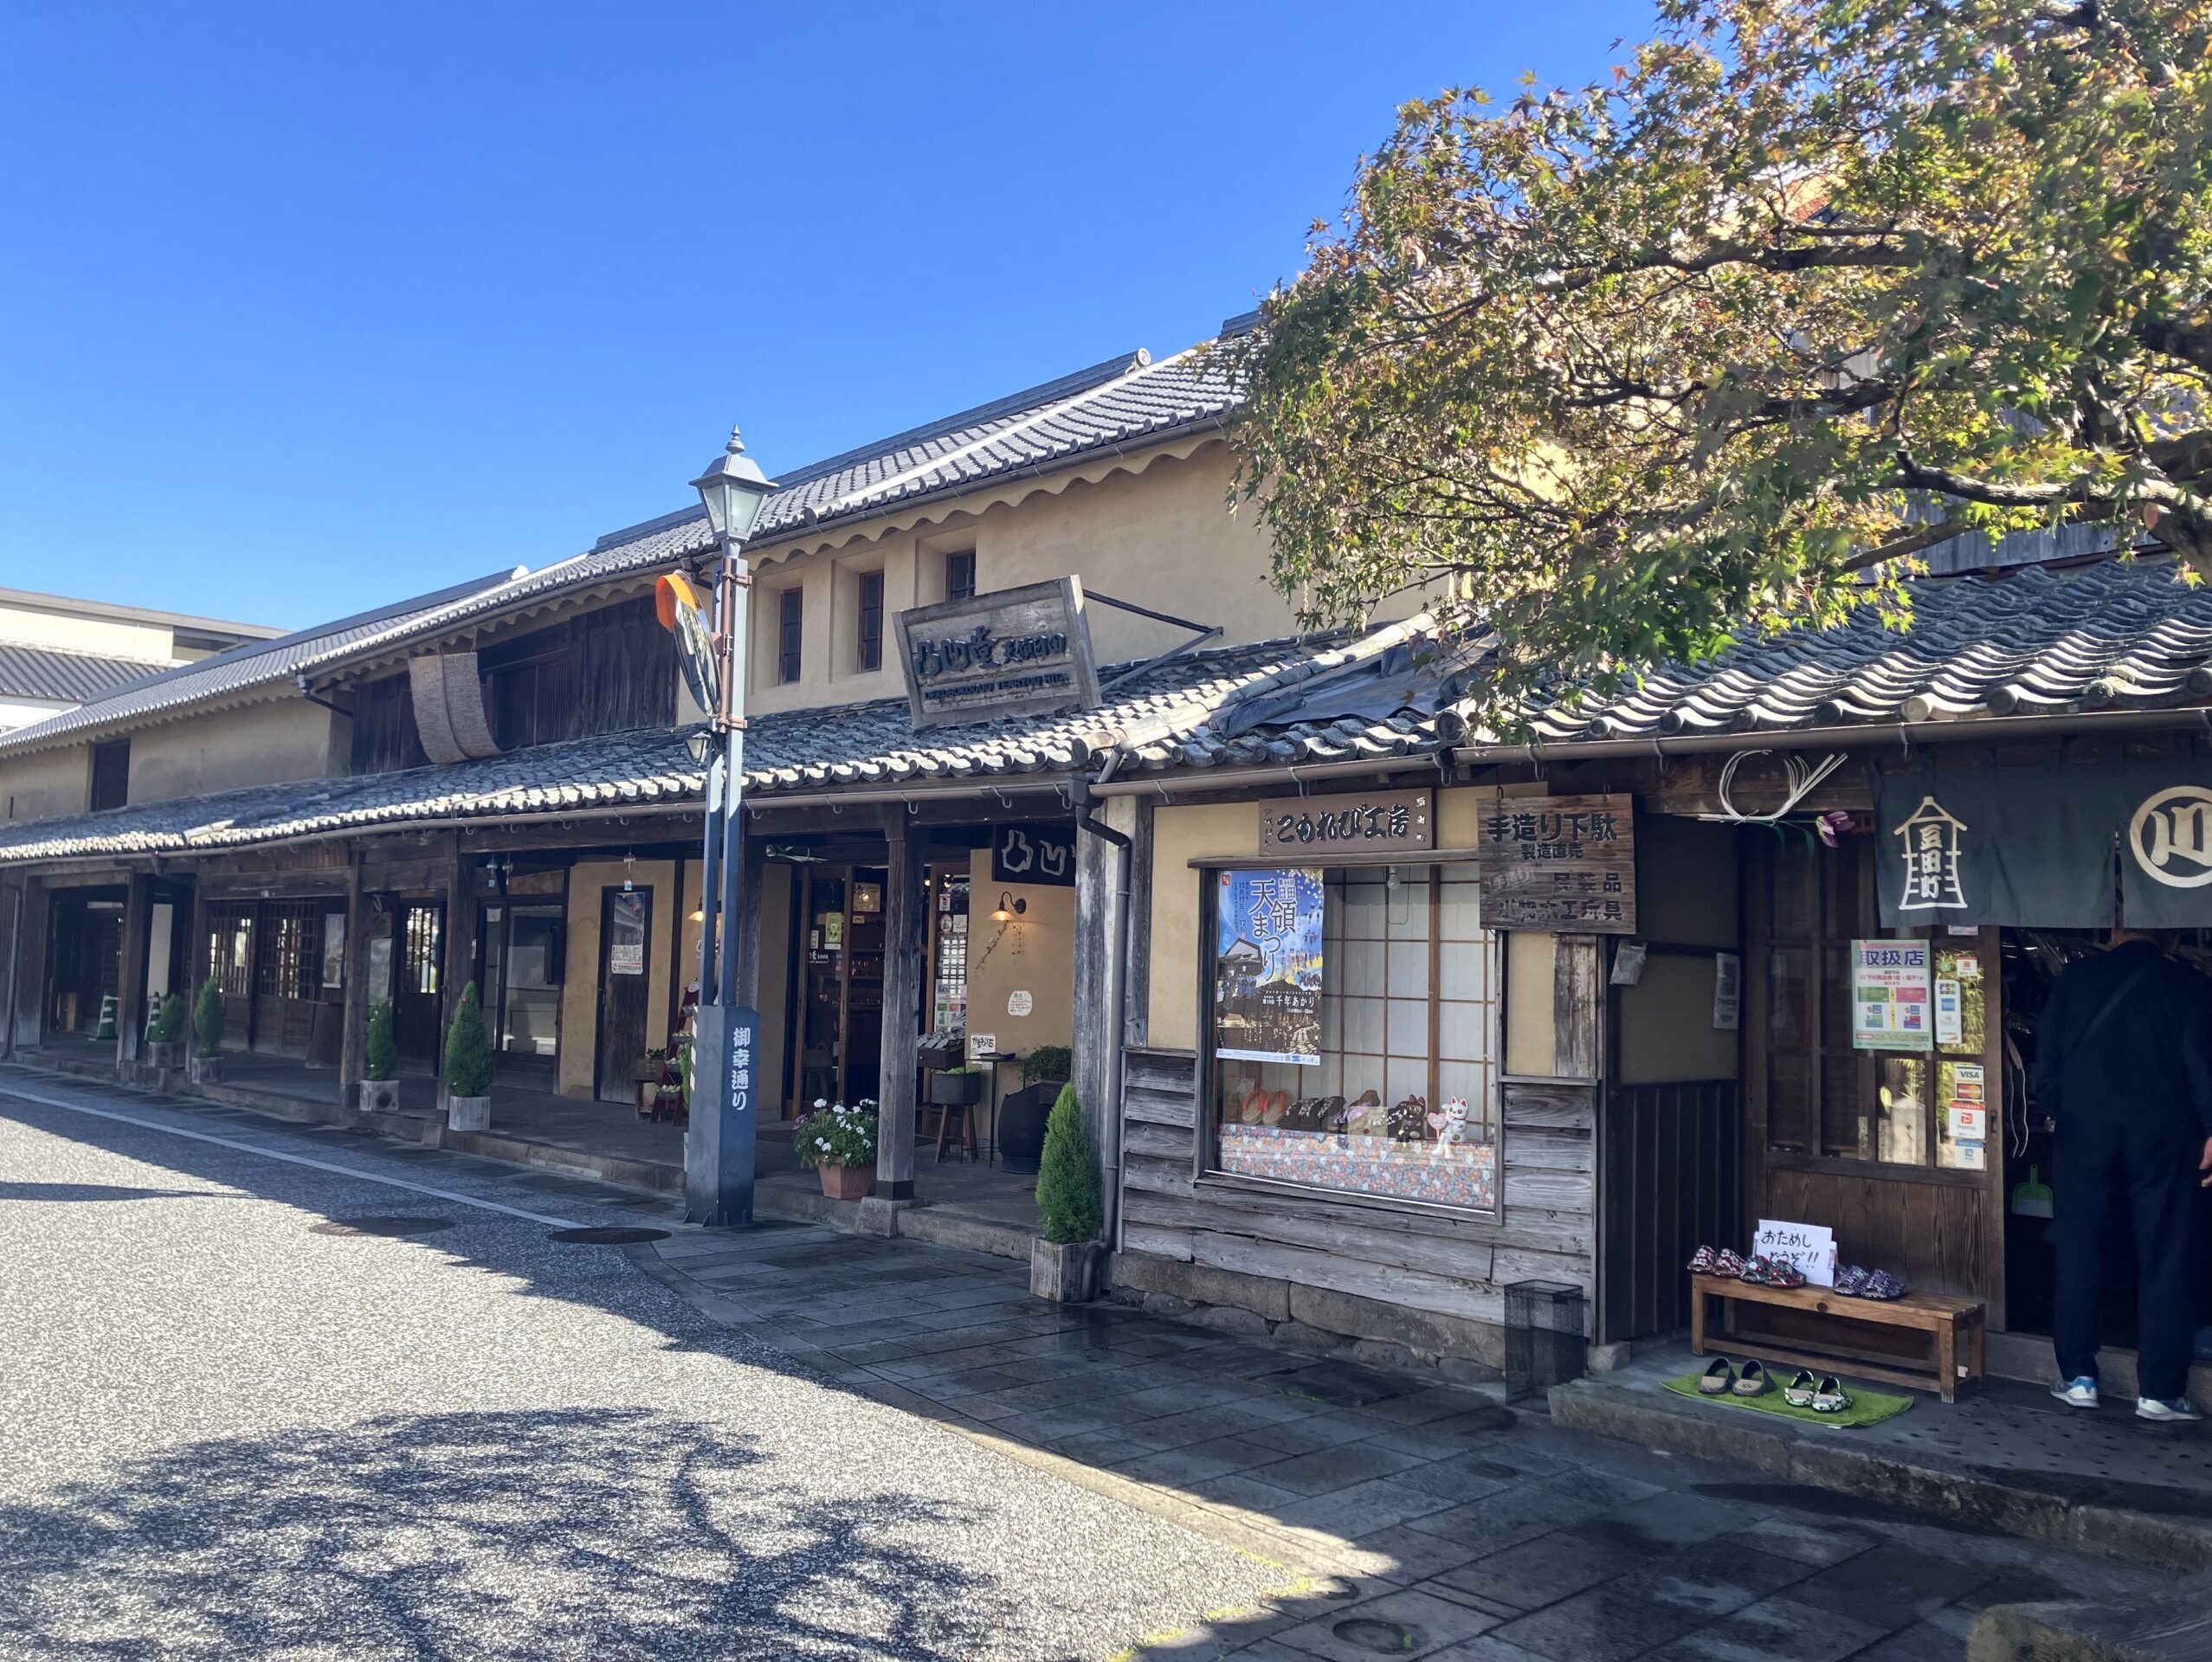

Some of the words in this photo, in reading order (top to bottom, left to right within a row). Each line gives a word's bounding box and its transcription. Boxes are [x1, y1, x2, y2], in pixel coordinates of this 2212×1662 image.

[1486, 812, 1617, 843] 手造り下駄
[1521, 843, 1584, 860] 製造直売
[1919, 823, 1943, 899] 豆田町
[1276, 995, 1315, 1007] 千年あかり
[732, 1027, 751, 1111] 御幸通り
[1761, 1230, 1811, 1247] おためし
